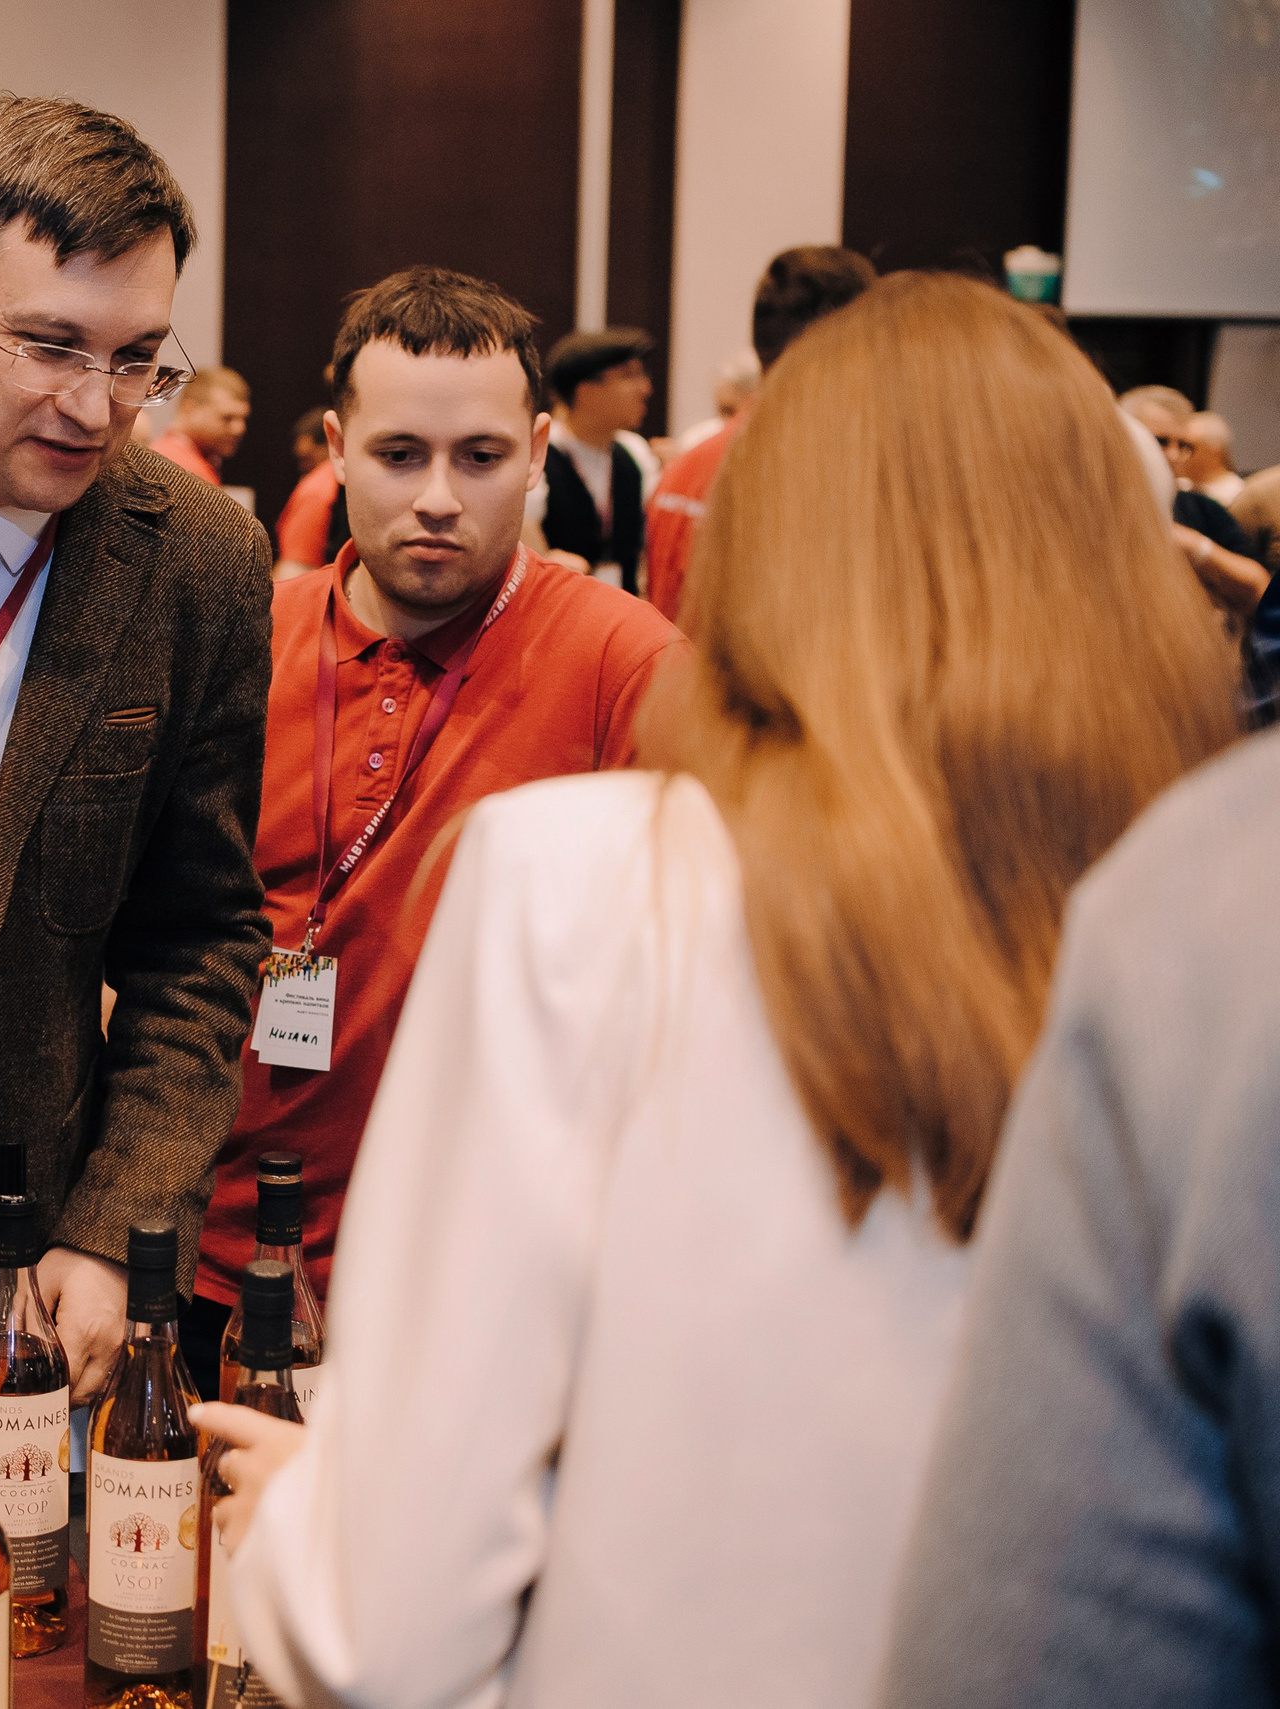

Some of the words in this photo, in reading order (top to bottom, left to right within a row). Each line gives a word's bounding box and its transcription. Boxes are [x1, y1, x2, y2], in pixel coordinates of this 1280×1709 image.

[0, 1485, 53, 1498] COGNAC
[94, 1473, 193, 1499] DOMAINES
[4, 1500, 48, 1516] VSOP
[111, 1558, 169, 1570] COGNAC
[114, 1573, 163, 1590] VSOP
